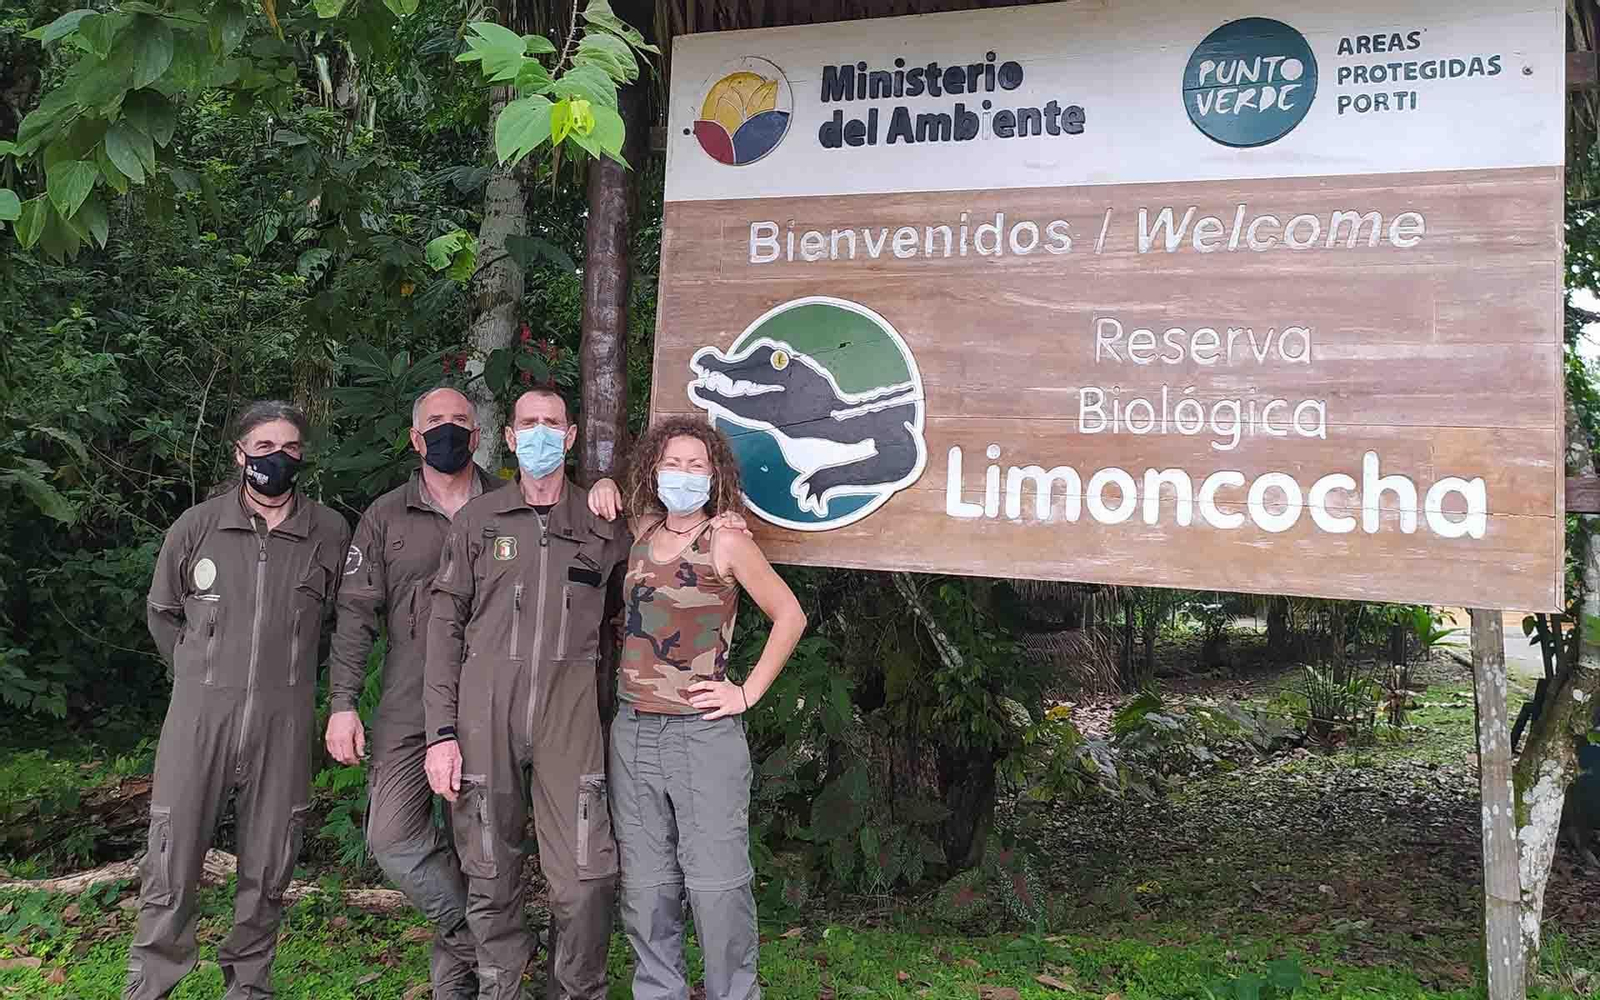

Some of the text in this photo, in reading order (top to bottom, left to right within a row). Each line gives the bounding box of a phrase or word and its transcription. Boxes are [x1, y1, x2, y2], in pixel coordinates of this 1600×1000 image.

[1337, 31, 1421, 55] AREAS
[821, 51, 1023, 102] Ministerio
[1198, 56, 1304, 84] PUNTO
[1337, 54, 1502, 85] PROTEGIDAS
[818, 99, 1086, 148] del Ambiente
[1196, 84, 1302, 116] VERDE
[748, 212, 1074, 264] Bienvenidos
[1137, 204, 1427, 254] Welcome
[1094, 316, 1313, 366] Reserva
[1078, 385, 1328, 451] Biológica
[945, 444, 1489, 540] Limoncocha
